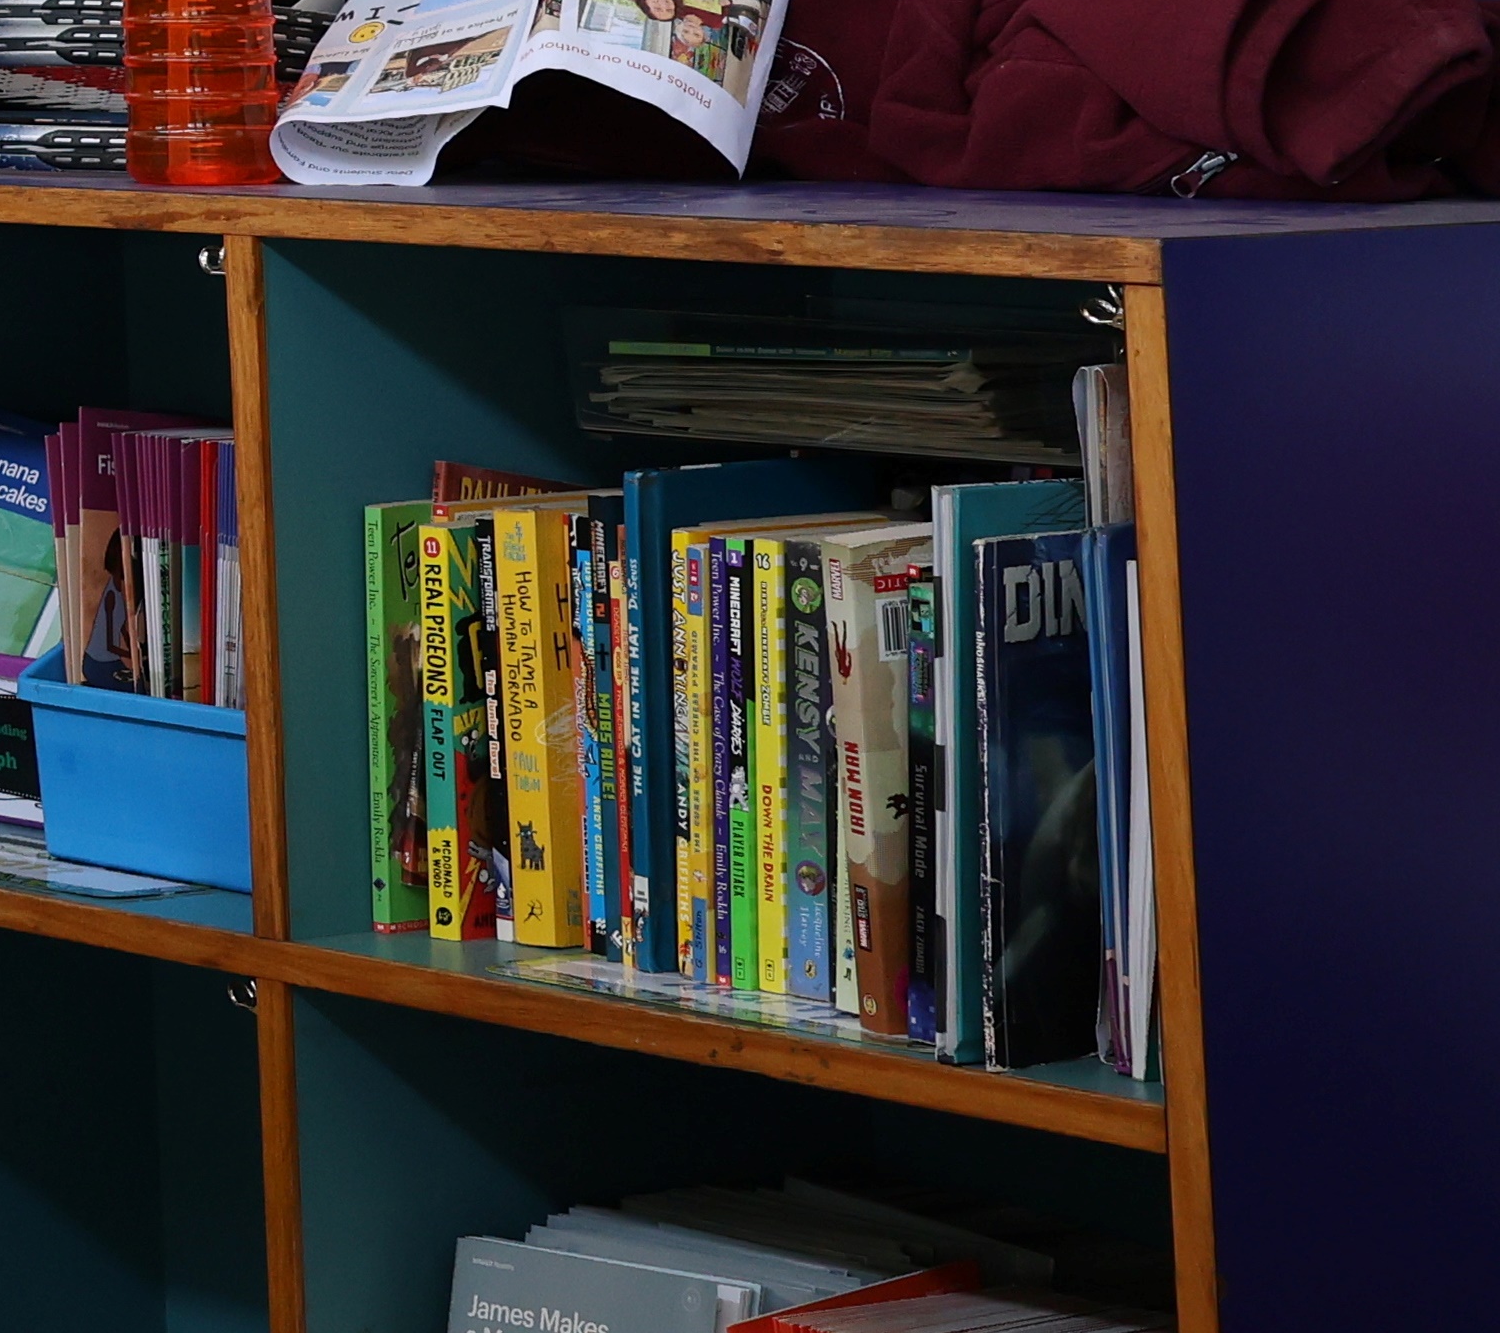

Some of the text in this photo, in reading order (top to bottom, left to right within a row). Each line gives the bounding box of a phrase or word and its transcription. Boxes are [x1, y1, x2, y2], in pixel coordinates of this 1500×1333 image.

[539, 41, 712, 109] Photos from our author
[478, 536, 496, 632] TRANSFORMERS
[515, 571, 537, 693] HOW TAME
[829, 559, 843, 600] MARVEL
[425, 563, 446, 781] REAL FLAP OUT
[502, 594, 522, 742] HUMAN TORNADO
[594, 520, 615, 801] MINECRAFT MOBS RULE!
[672, 550, 691, 921] JUST ANDY GRIFFITHS
[729, 576, 745, 897] MINECRAFT WOLF PLAYER ATTACK
[795, 620, 822, 856] KENSY MAX
[844, 742, 864, 835] IRON MAN
[594, 834, 605, 895] GRIFFITHS
[714, 779, 727, 879] Claude Emily
[762, 785, 775, 902] DOWN THE DRAIN
[914, 764, 928, 879] Survival Mode
[467, 1295, 534, 1329] James
